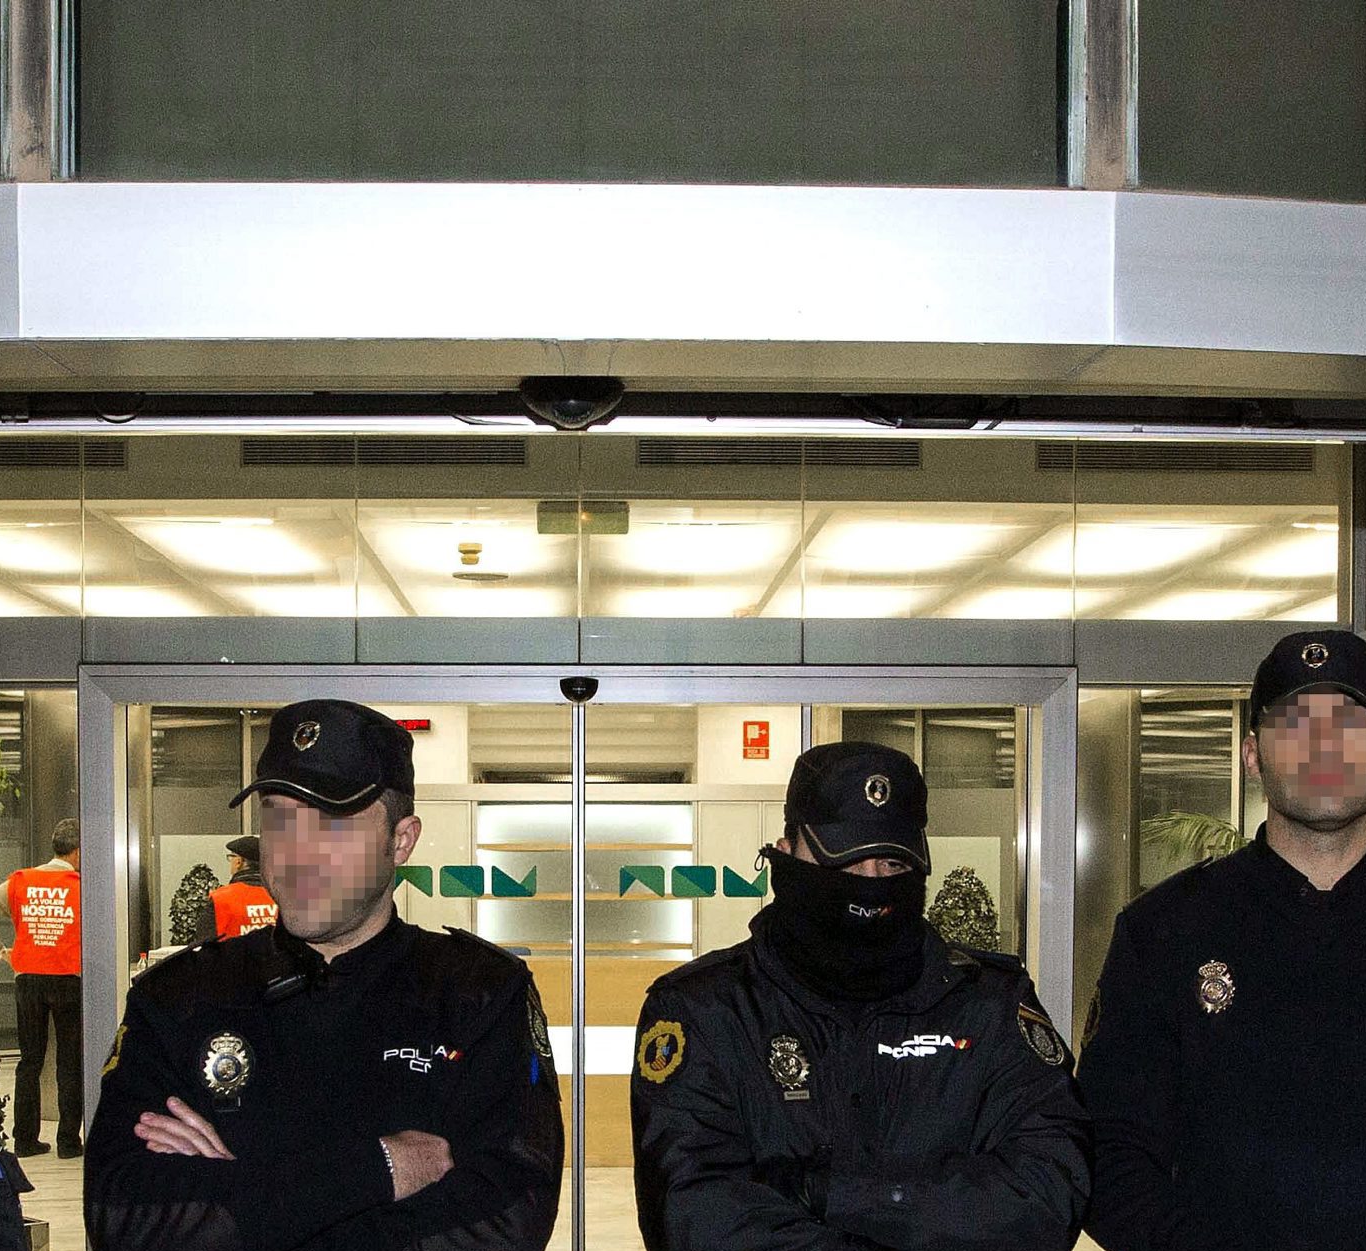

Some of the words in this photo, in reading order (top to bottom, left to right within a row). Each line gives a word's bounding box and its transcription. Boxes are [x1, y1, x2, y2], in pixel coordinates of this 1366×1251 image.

[26, 886, 70, 899] RTVV
[20, 904, 75, 918] NOSTRA
[246, 904, 278, 917] RTV
